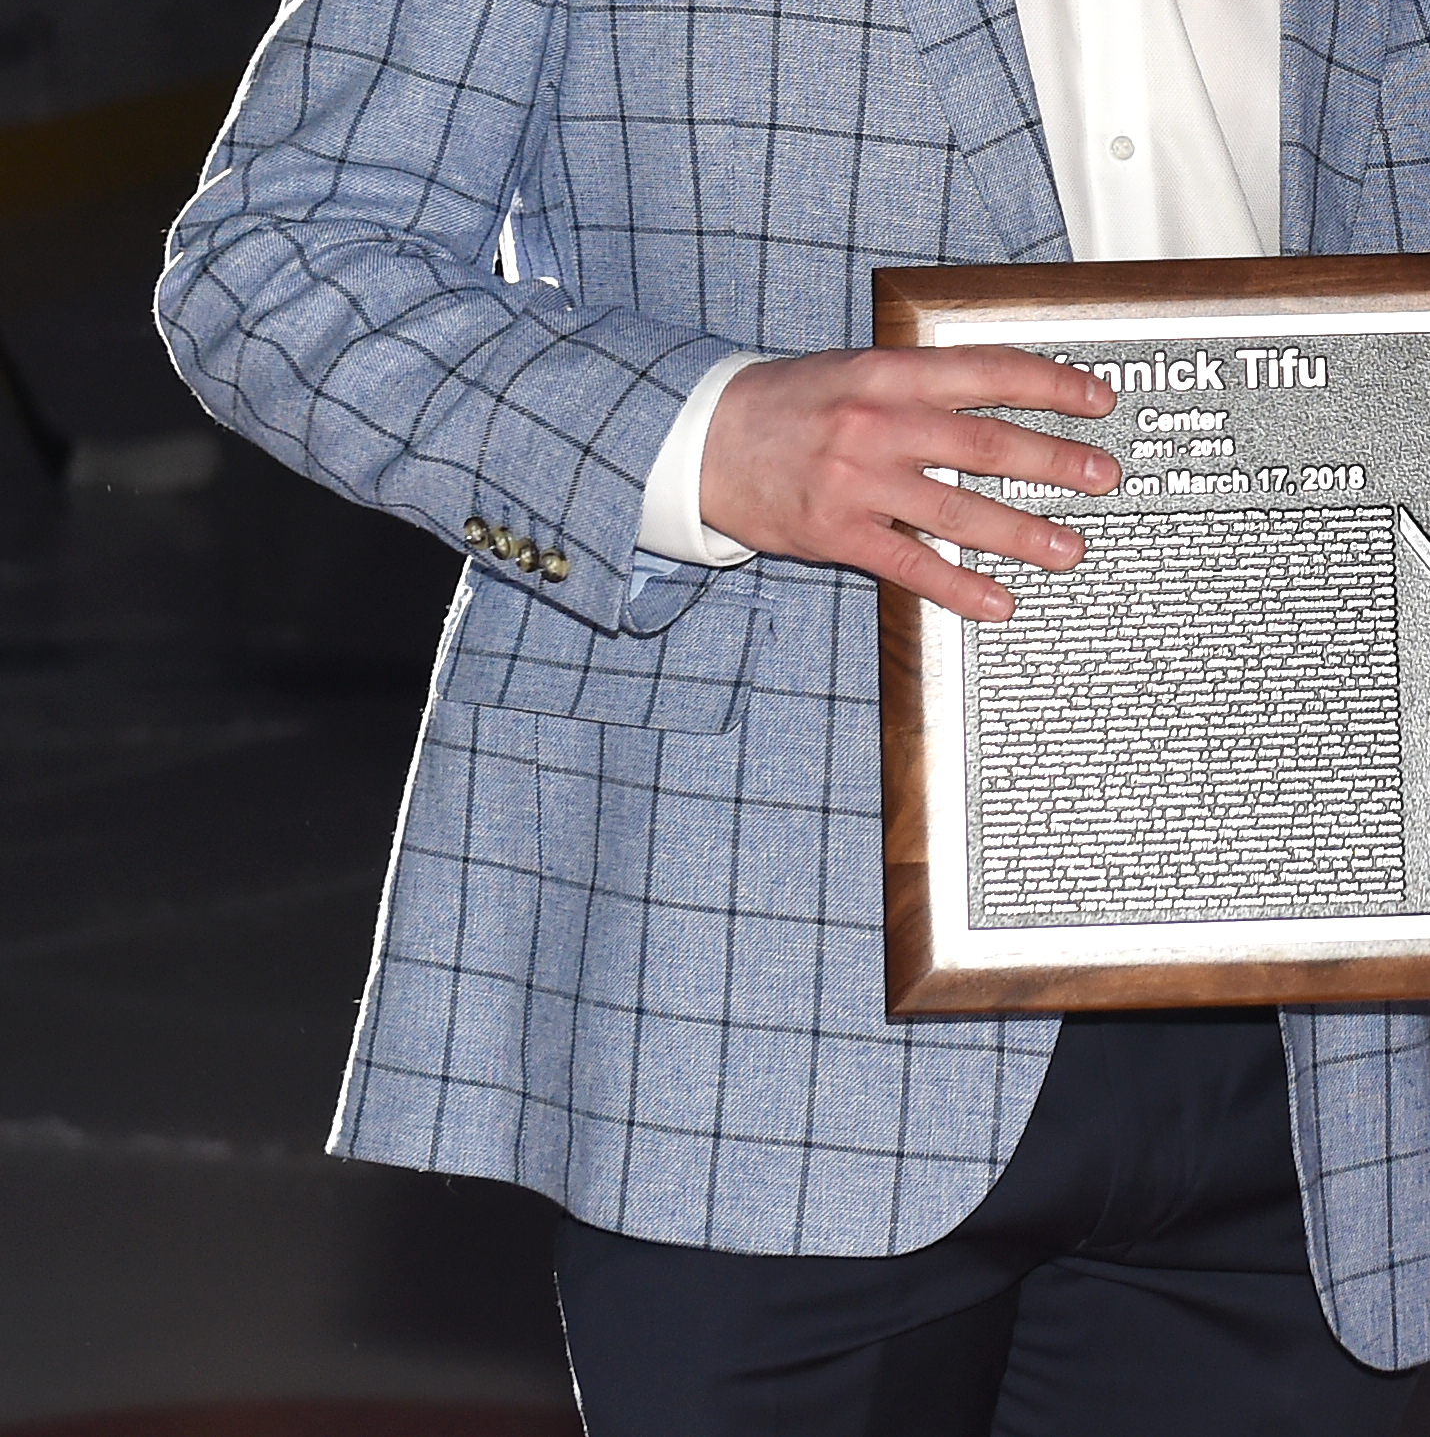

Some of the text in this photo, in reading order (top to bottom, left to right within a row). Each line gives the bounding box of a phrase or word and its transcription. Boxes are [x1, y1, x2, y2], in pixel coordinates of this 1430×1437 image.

[1053, 348, 1328, 393] nnick Tifu
[1136, 407, 1229, 433] Center
[1130, 439, 1174, 460] 2011
[1125, 475, 1161, 496] on
[1166, 468, 1250, 495] March
[1256, 467, 1297, 496] 17,
[1301, 464, 1366, 492] 2018
